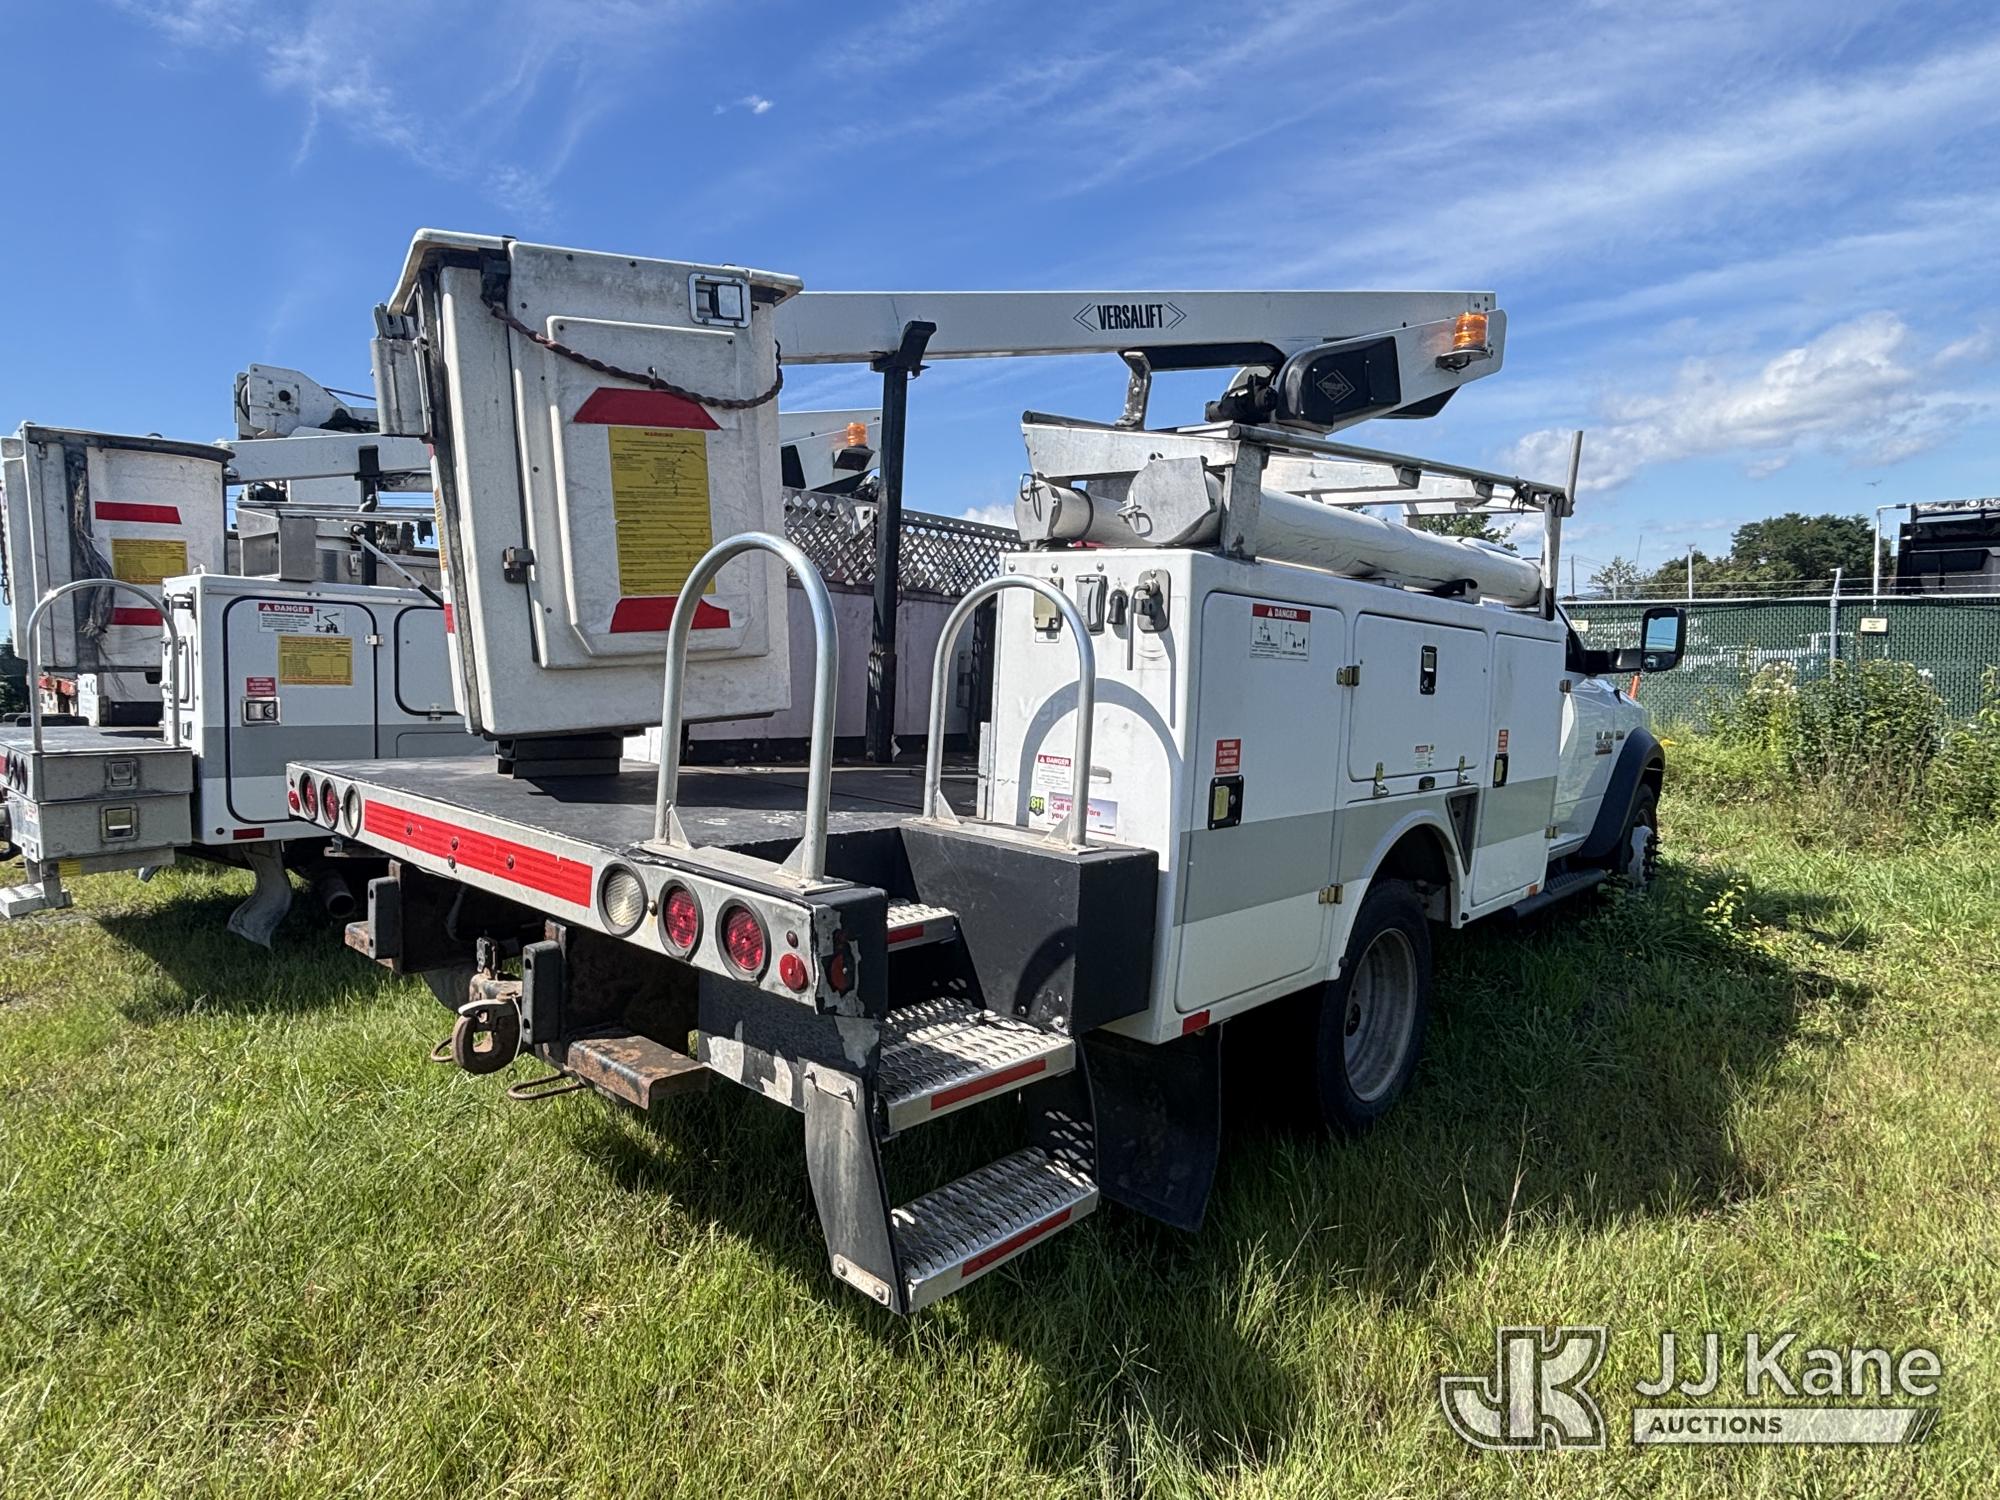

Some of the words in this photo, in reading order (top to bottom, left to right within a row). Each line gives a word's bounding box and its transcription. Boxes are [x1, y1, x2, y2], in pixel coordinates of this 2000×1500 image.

[1097, 304, 1163, 330] VERSALIFT
[273, 604, 310, 613] DANGER
[1274, 608, 1298, 619] DANGER
[1046, 757, 1070, 765] DANGER
[1031, 796, 1043, 810] 811
